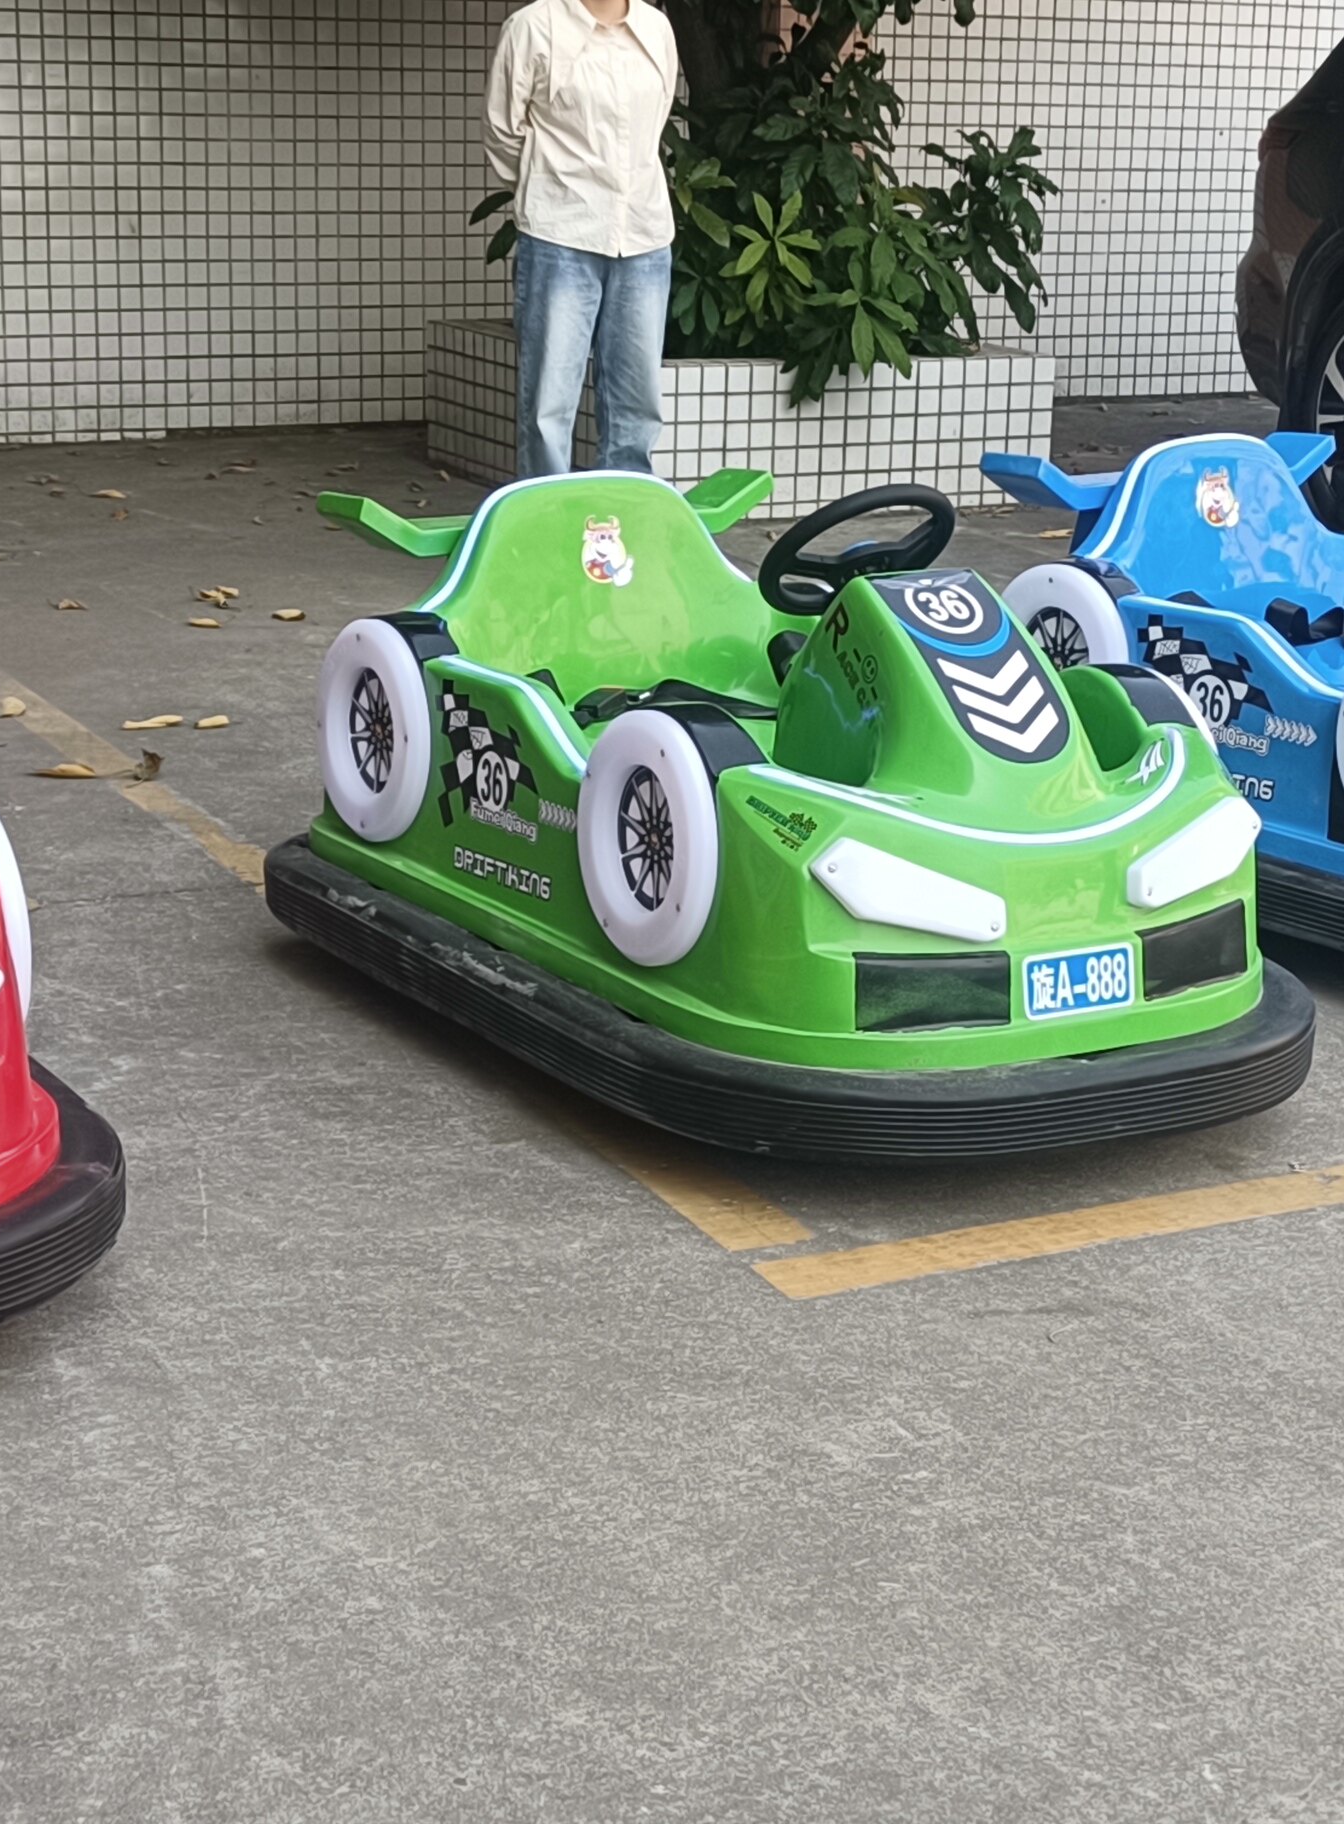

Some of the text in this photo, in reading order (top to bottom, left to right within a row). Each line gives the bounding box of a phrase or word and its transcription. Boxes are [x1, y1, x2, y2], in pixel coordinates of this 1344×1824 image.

[917, 590, 970, 622] 36
[1195, 681, 1224, 723] 36
[480, 758, 504, 807] 36
[1030, 952, 1127, 1011] 旋A-888
